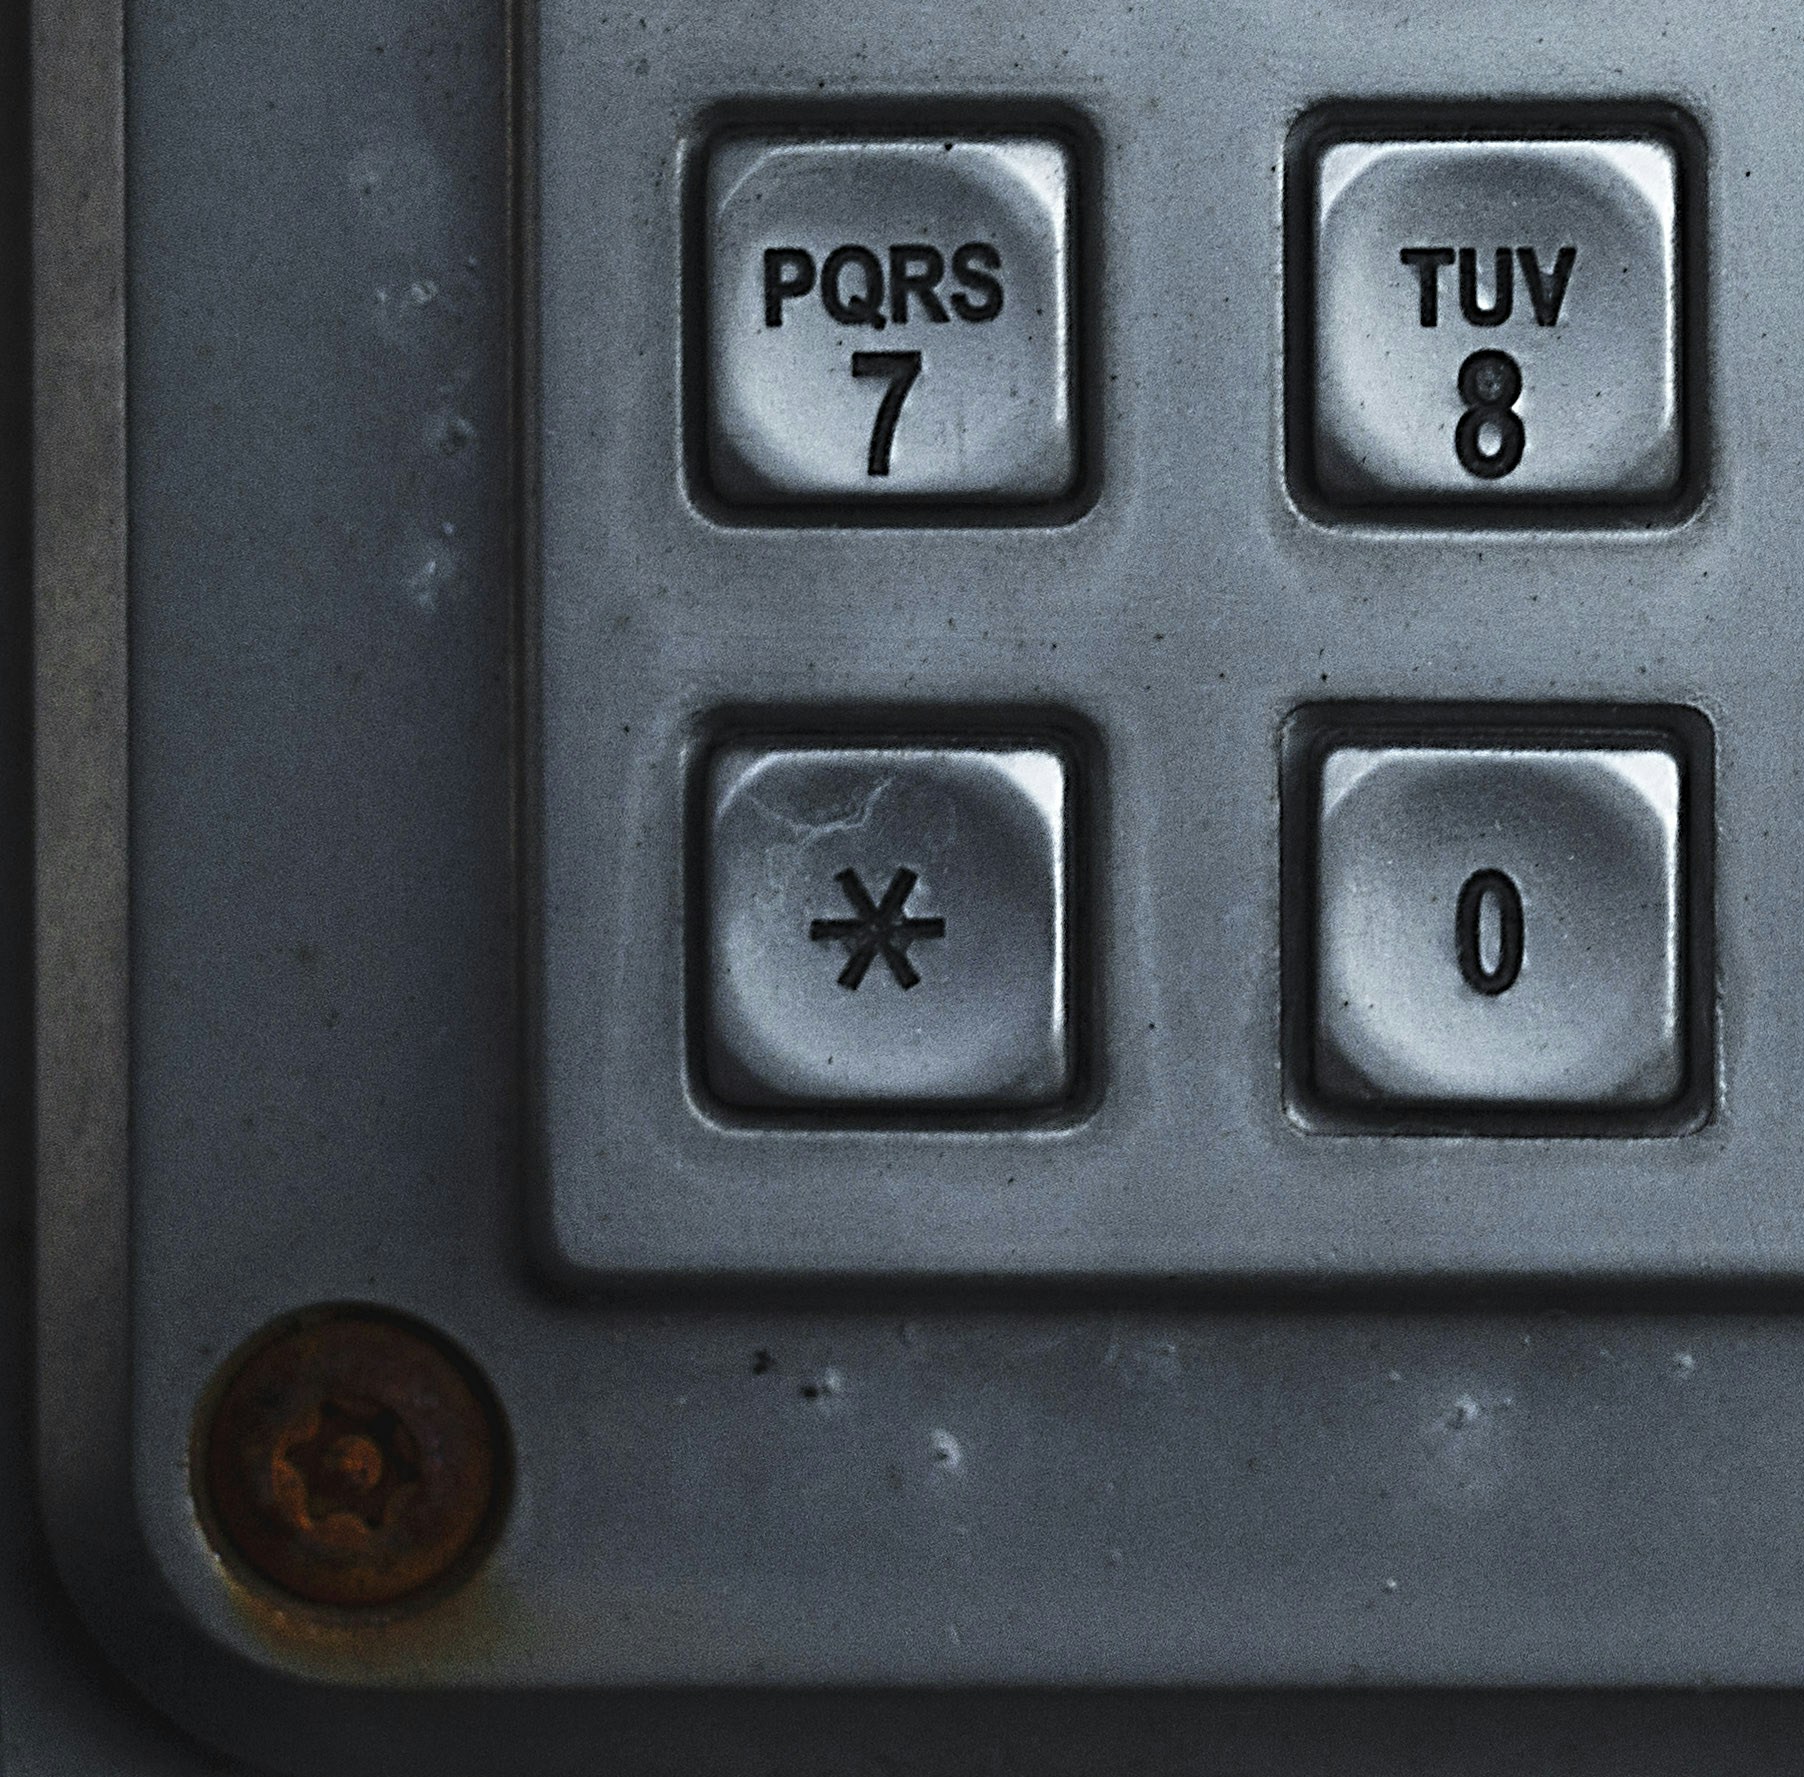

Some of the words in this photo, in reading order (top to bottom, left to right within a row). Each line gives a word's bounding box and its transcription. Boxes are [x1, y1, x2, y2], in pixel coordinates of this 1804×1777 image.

[764, 241, 1003, 330] PQRS
[1400, 246, 1577, 327] TUV
[851, 350, 922, 477] 7
[1453, 349, 1527, 482] 8
[1455, 867, 1524, 997] 0
